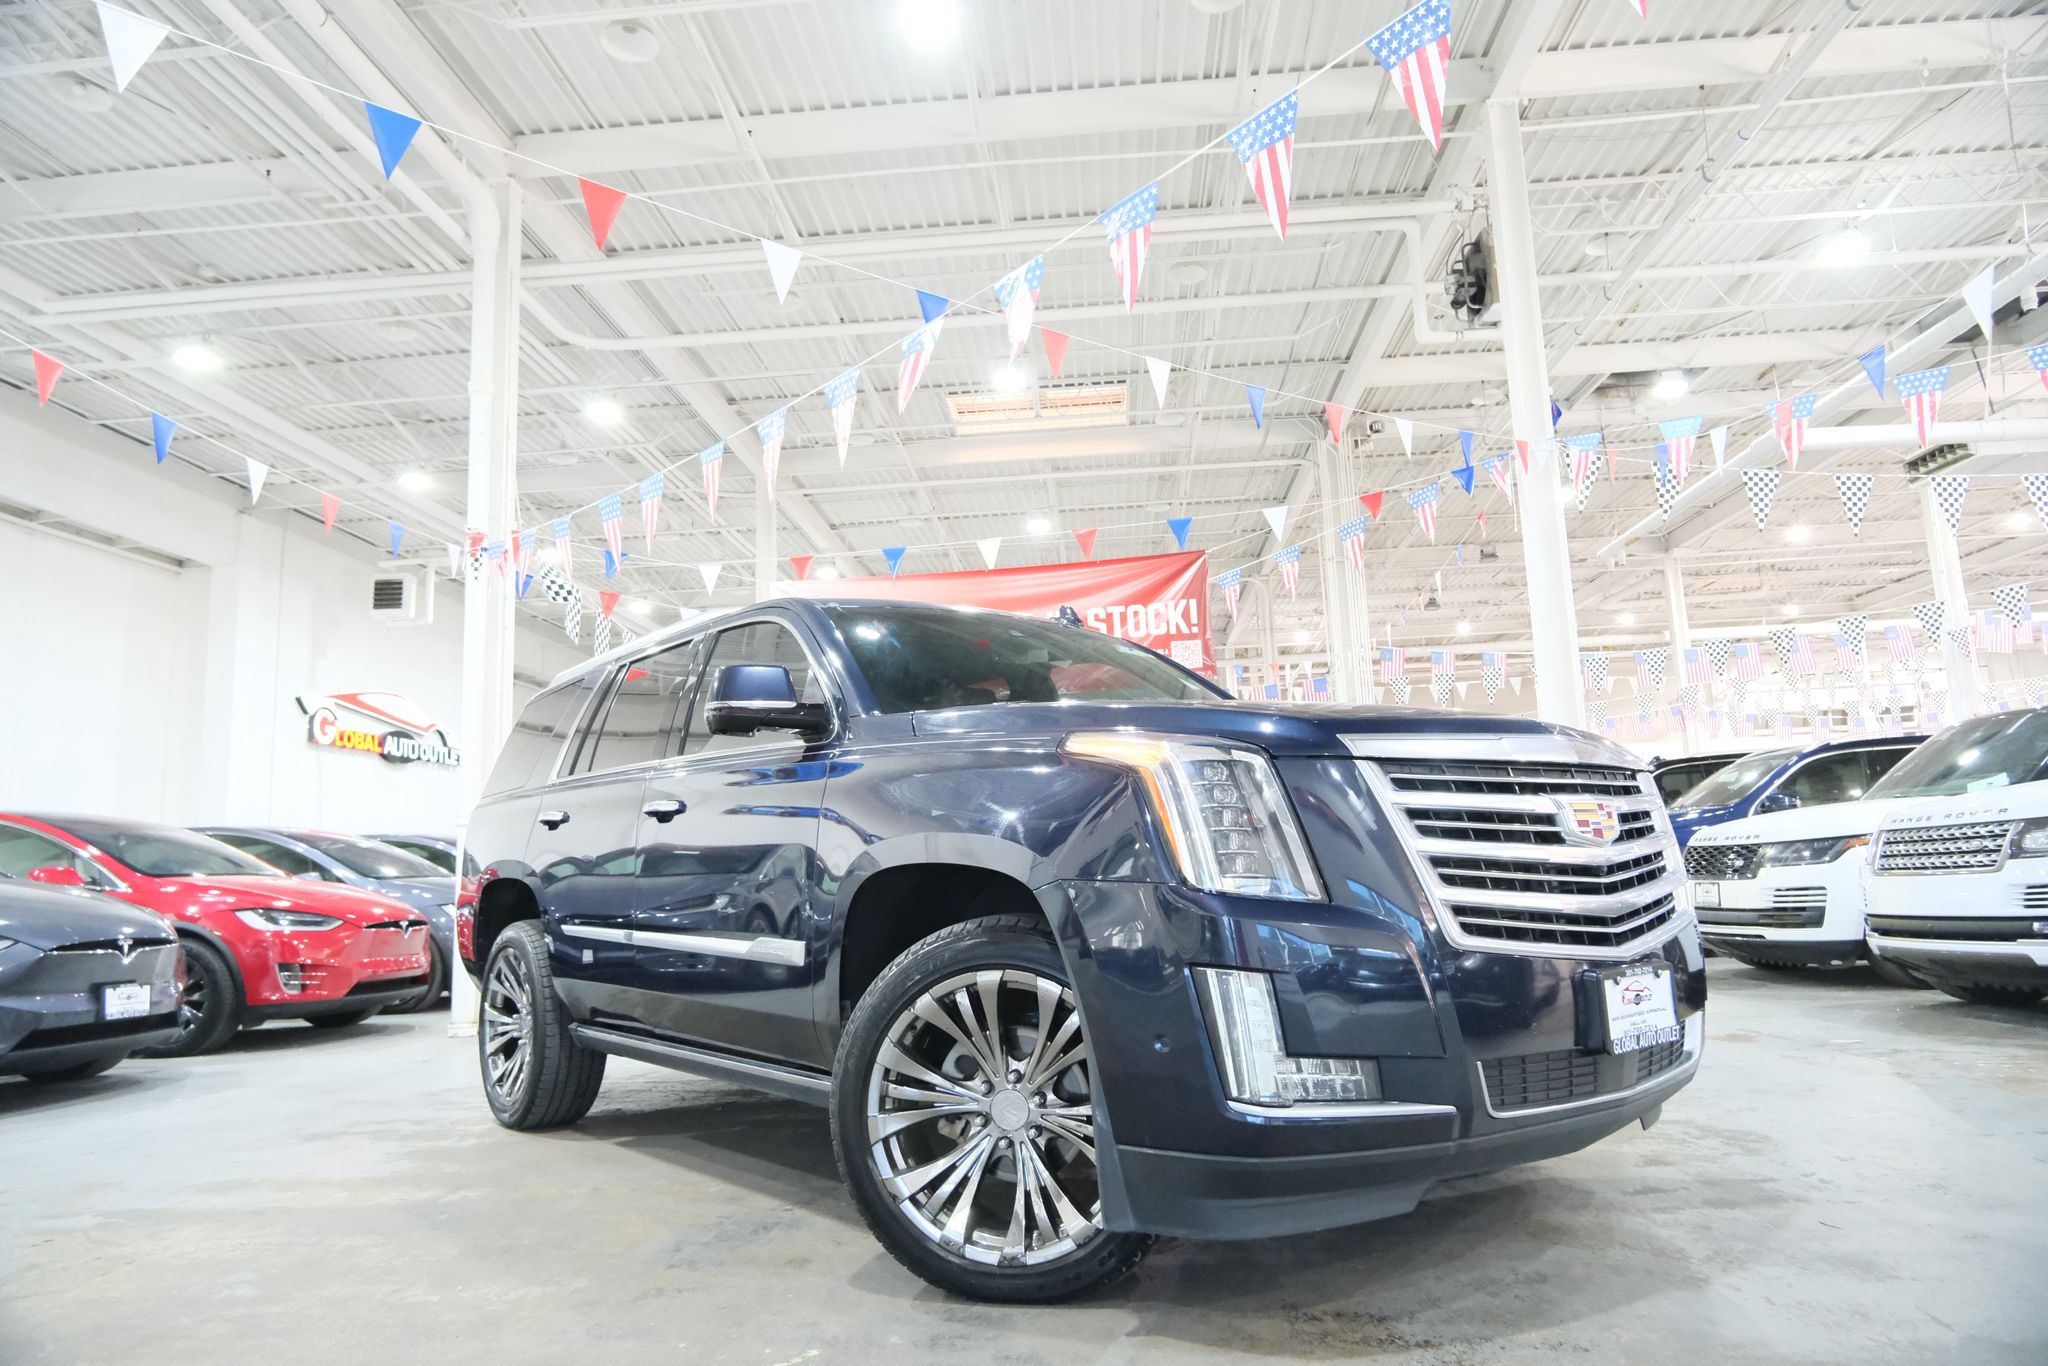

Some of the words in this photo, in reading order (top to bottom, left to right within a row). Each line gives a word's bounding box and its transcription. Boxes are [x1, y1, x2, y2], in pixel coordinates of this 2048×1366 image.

[1087, 598, 1199, 639] STOCK!
[312, 707, 382, 753] GLOBAL
[383, 735, 418, 760] AUTO
[1944, 808, 2009, 820] ROVER
[1613, 1034, 1640, 1055] GLOBAL
[1640, 1029, 1657, 1048] AUTO
[1657, 1025, 1681, 1045] OUTLET
